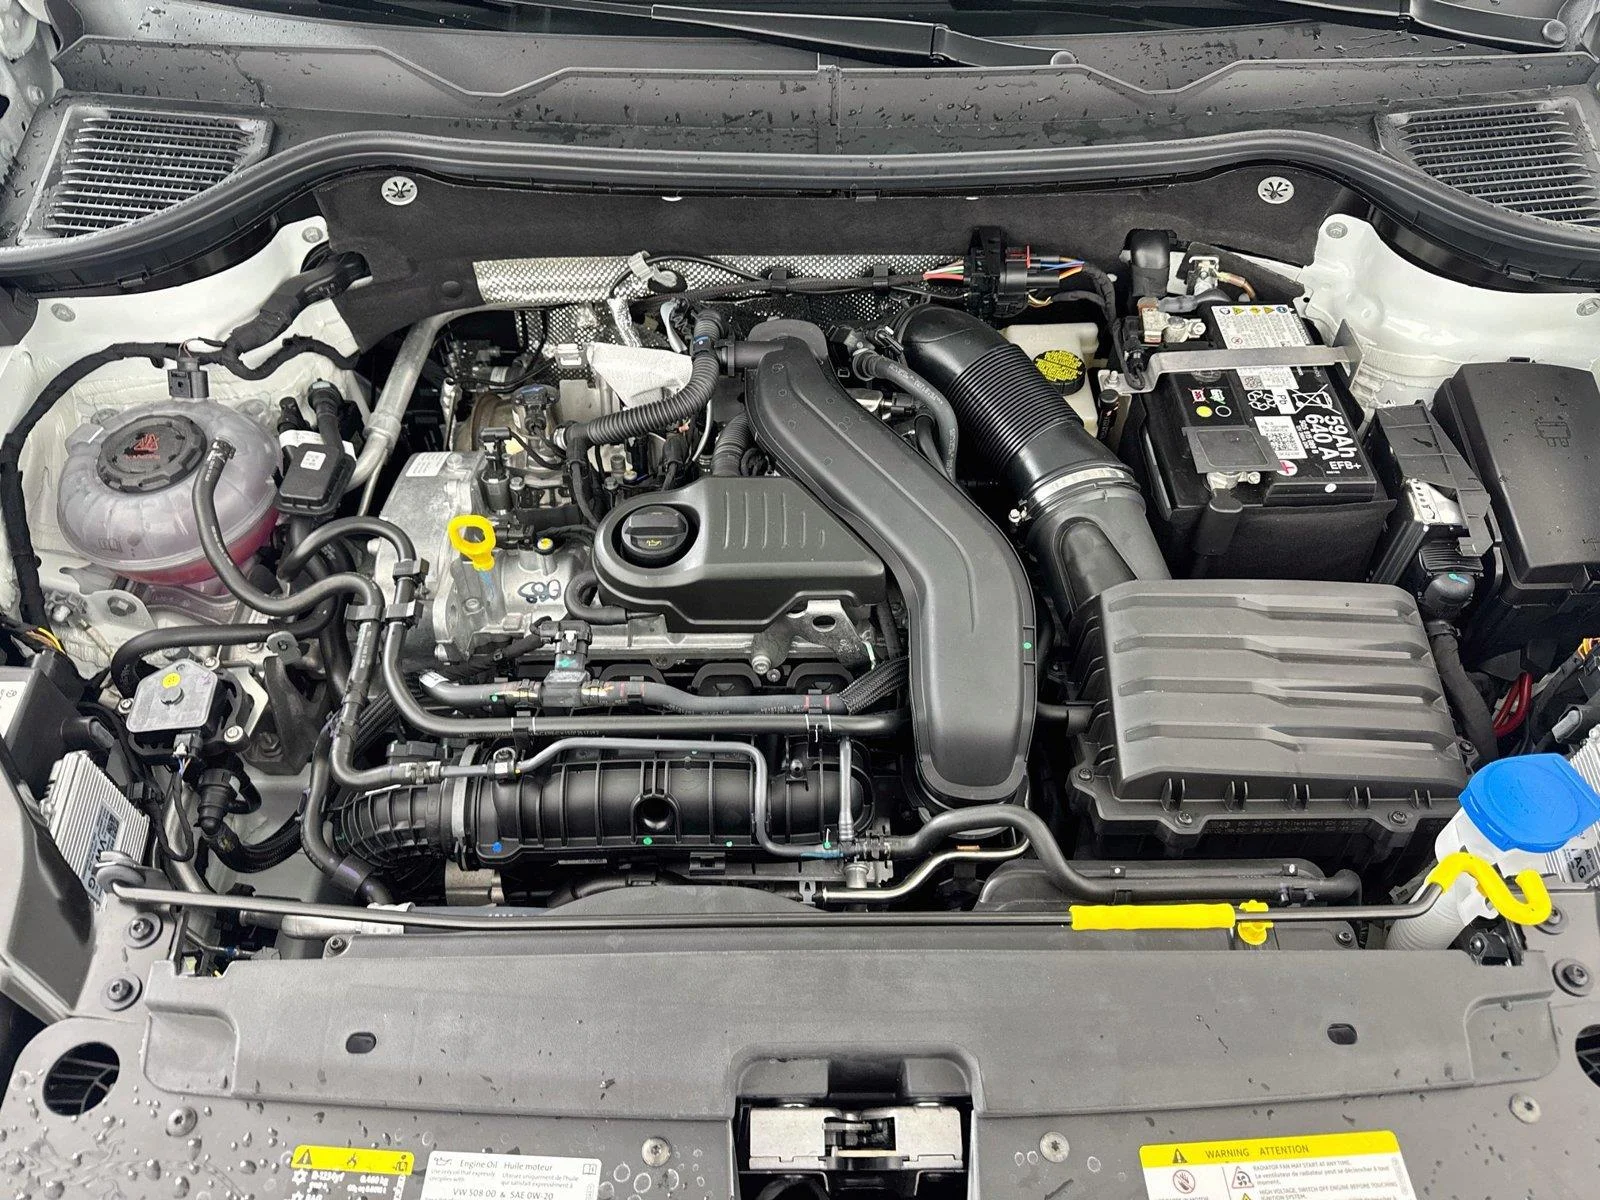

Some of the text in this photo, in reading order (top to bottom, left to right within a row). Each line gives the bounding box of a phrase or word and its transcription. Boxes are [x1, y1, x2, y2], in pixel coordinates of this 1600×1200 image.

[1305, 414, 1333, 444] 640
[1324, 415, 1358, 458] 59Ah
[1318, 447, 1340, 460] A
[1329, 461, 1361, 470] EFB+
[1205, 1144, 1309, 1159] WARNING ATTENTION
[460, 1160, 498, 1170] Engine Oil
[504, 1162, 524, 1170] Huile
[453, 1188, 497, 1198] VW 508 00
[510, 1190, 555, 1200] SAE 0W-20
